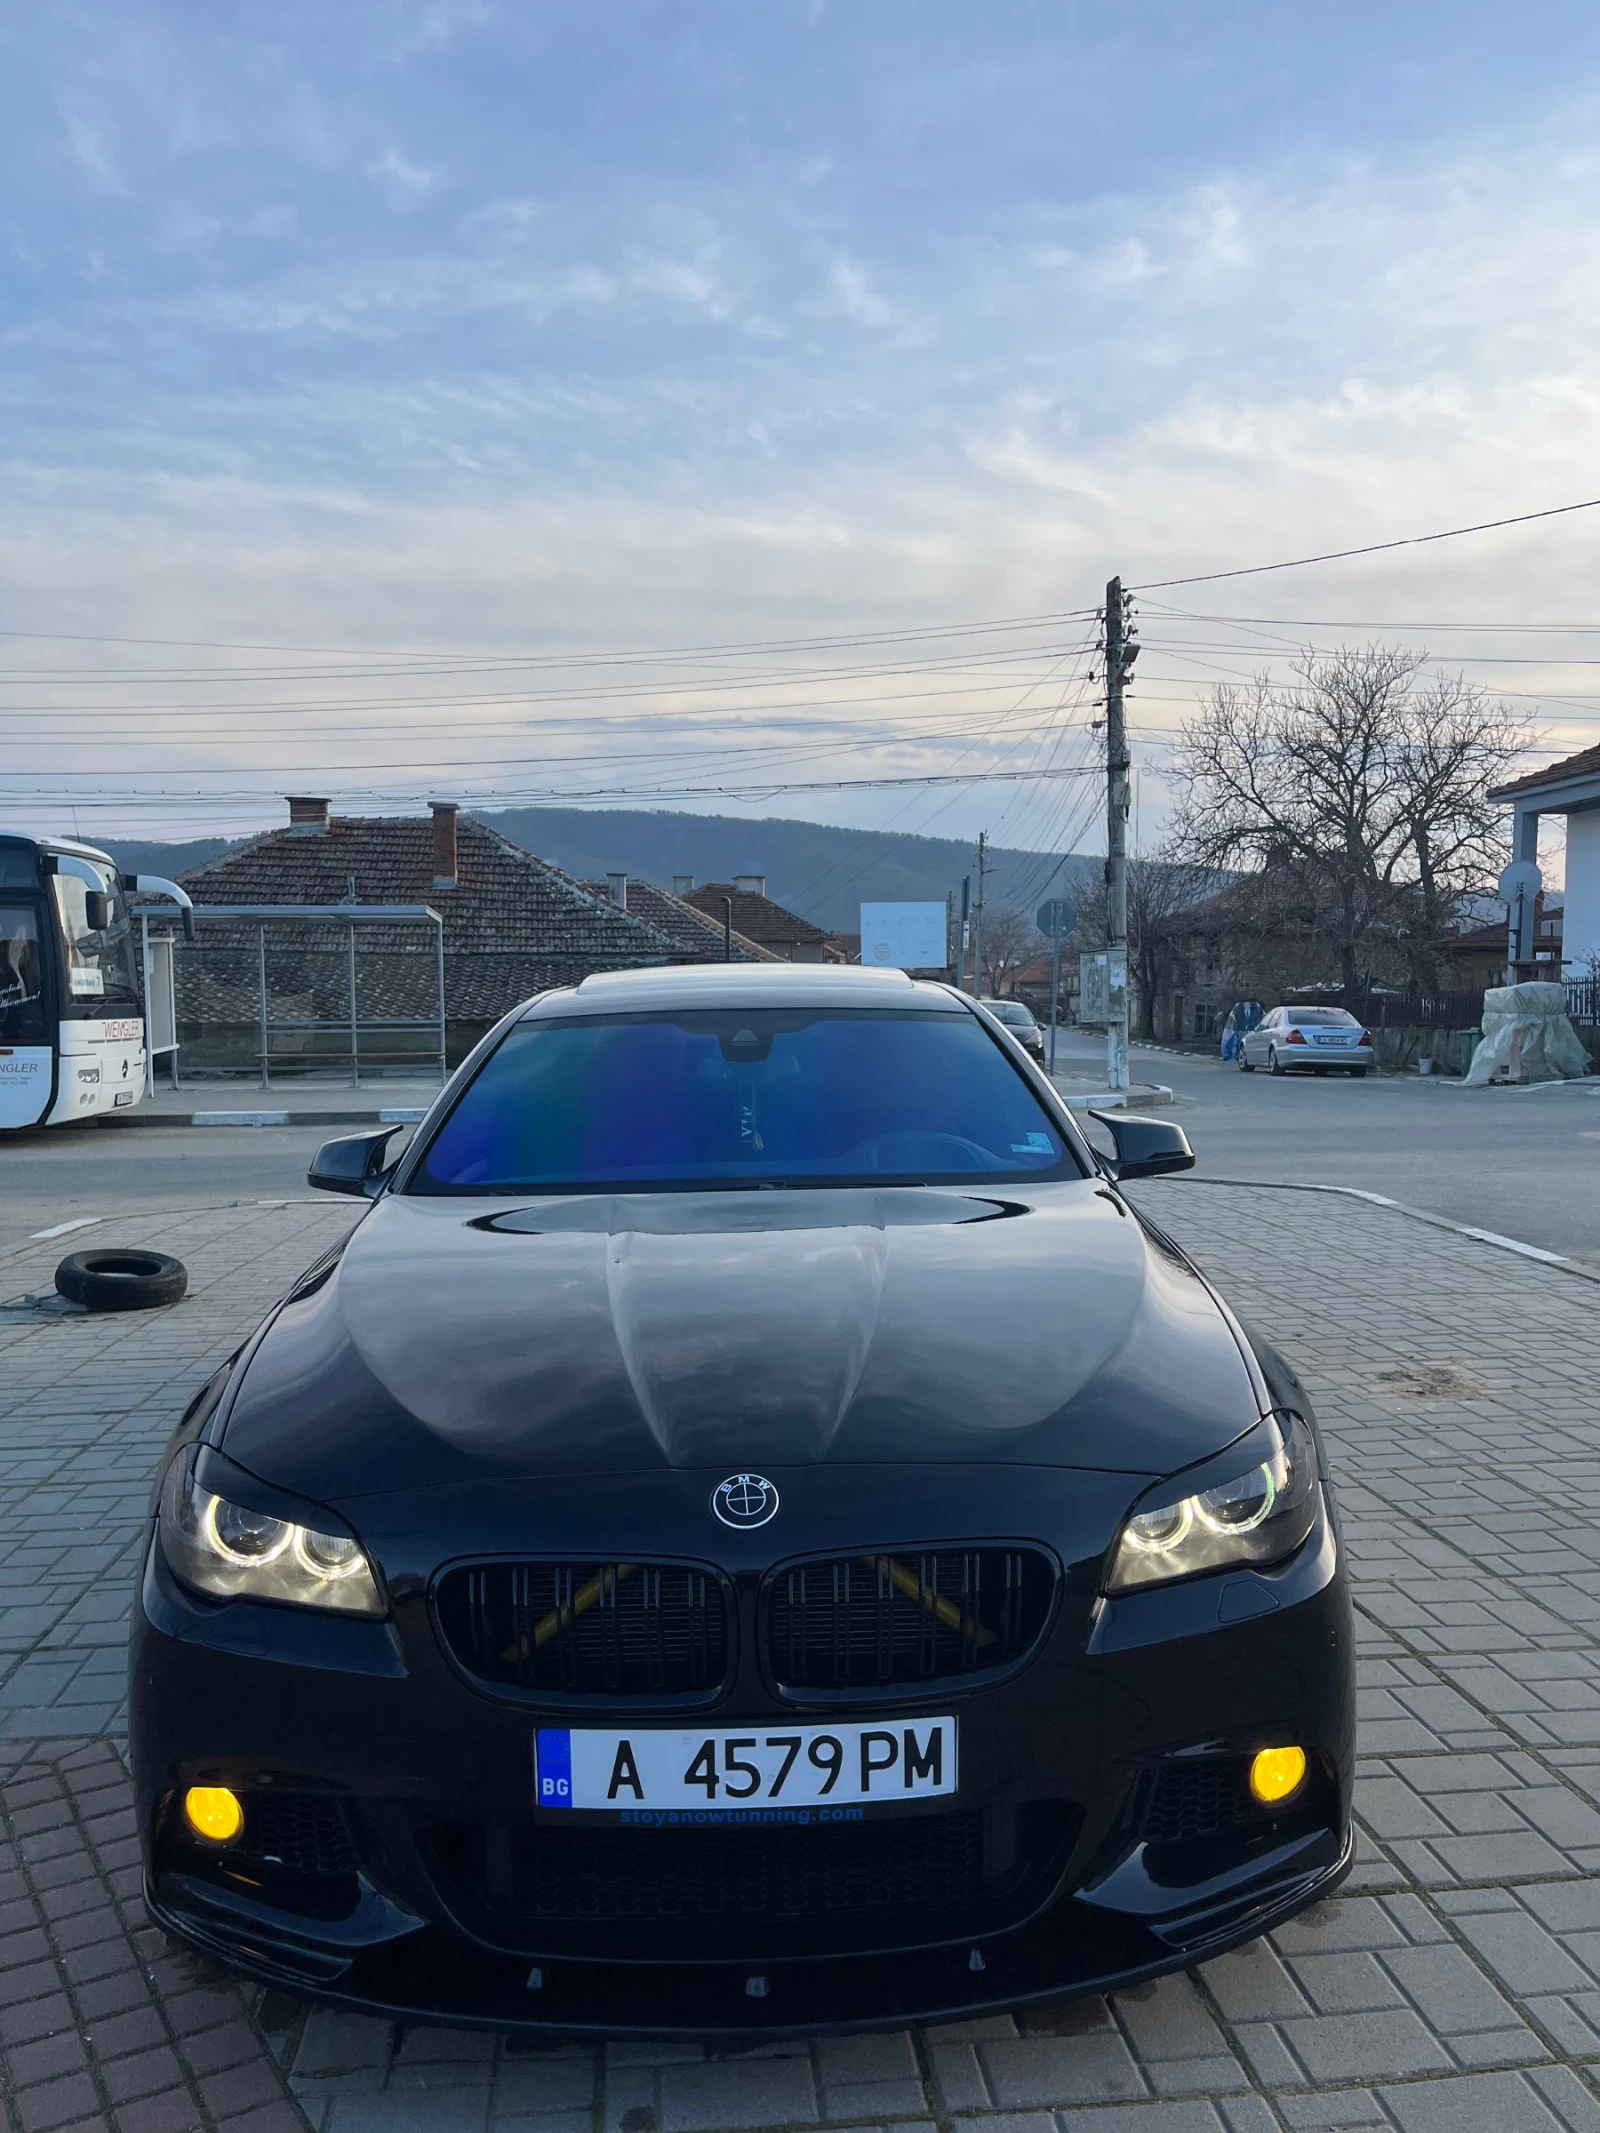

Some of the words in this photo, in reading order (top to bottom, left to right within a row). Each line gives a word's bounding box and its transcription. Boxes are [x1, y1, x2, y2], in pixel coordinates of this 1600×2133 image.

[102, 1020, 139, 1038] WENGLER
[720, 1475, 771, 1493] BMW
[542, 1777, 569, 1796] BG
[607, 1739, 644, 1800] A
[684, 1734, 844, 1799] 4579
[860, 1727, 943, 1792] PM
[620, 1807, 863, 1827] stoyanowtunning.com
